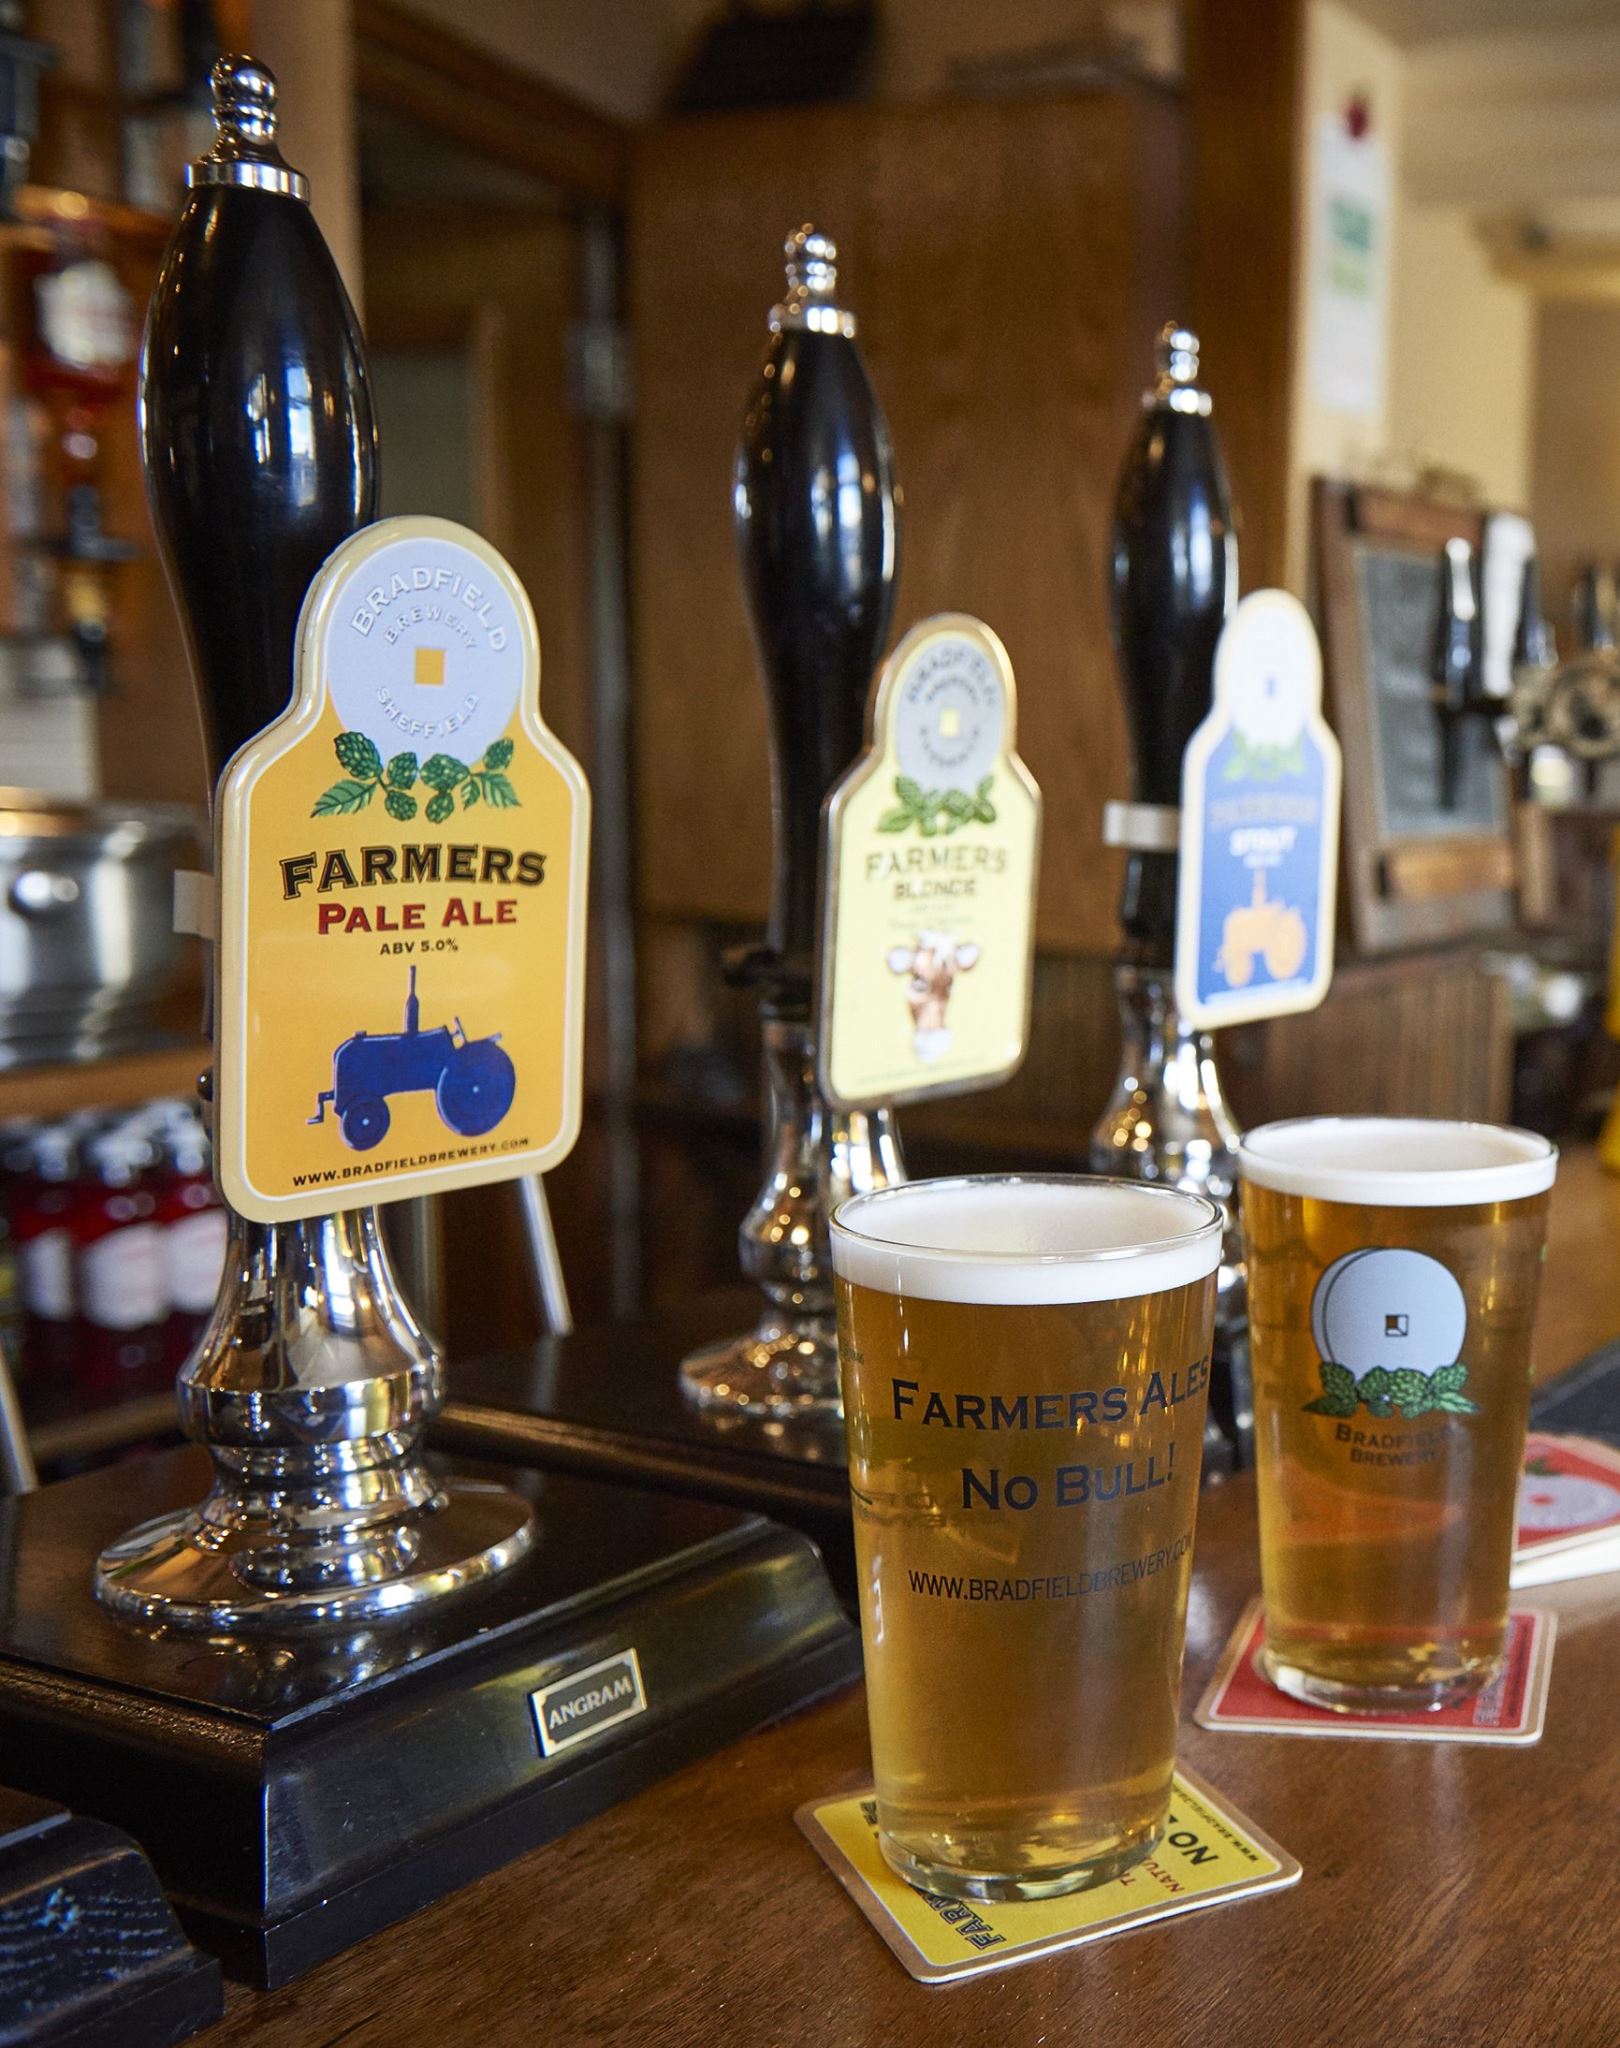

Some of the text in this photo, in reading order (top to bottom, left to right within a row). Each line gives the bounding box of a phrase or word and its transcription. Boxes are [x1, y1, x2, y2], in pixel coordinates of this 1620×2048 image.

[351, 566, 507, 653] BRADFIELD
[384, 604, 477, 645] BREWERY
[375, 685, 480, 739] SHEFFIELD
[278, 843, 547, 901] FARMERS
[865, 847, 1008, 883] FARMERS
[317, 897, 518, 936] PALE ALE
[379, 937, 459, 956] ABV 5.0%
[292, 1137, 530, 1188] WWW.BRADFIELDBREWERY.COM
[892, 1377, 1128, 1431] FARMERS
[961, 1441, 1176, 1511] NO BULL!
[908, 1533, 1193, 1601] WWW.BRADFIELDBREWERY.CO
[549, 1676, 633, 1730] ANGRAM
[1168, 1831, 1219, 1866] NO
